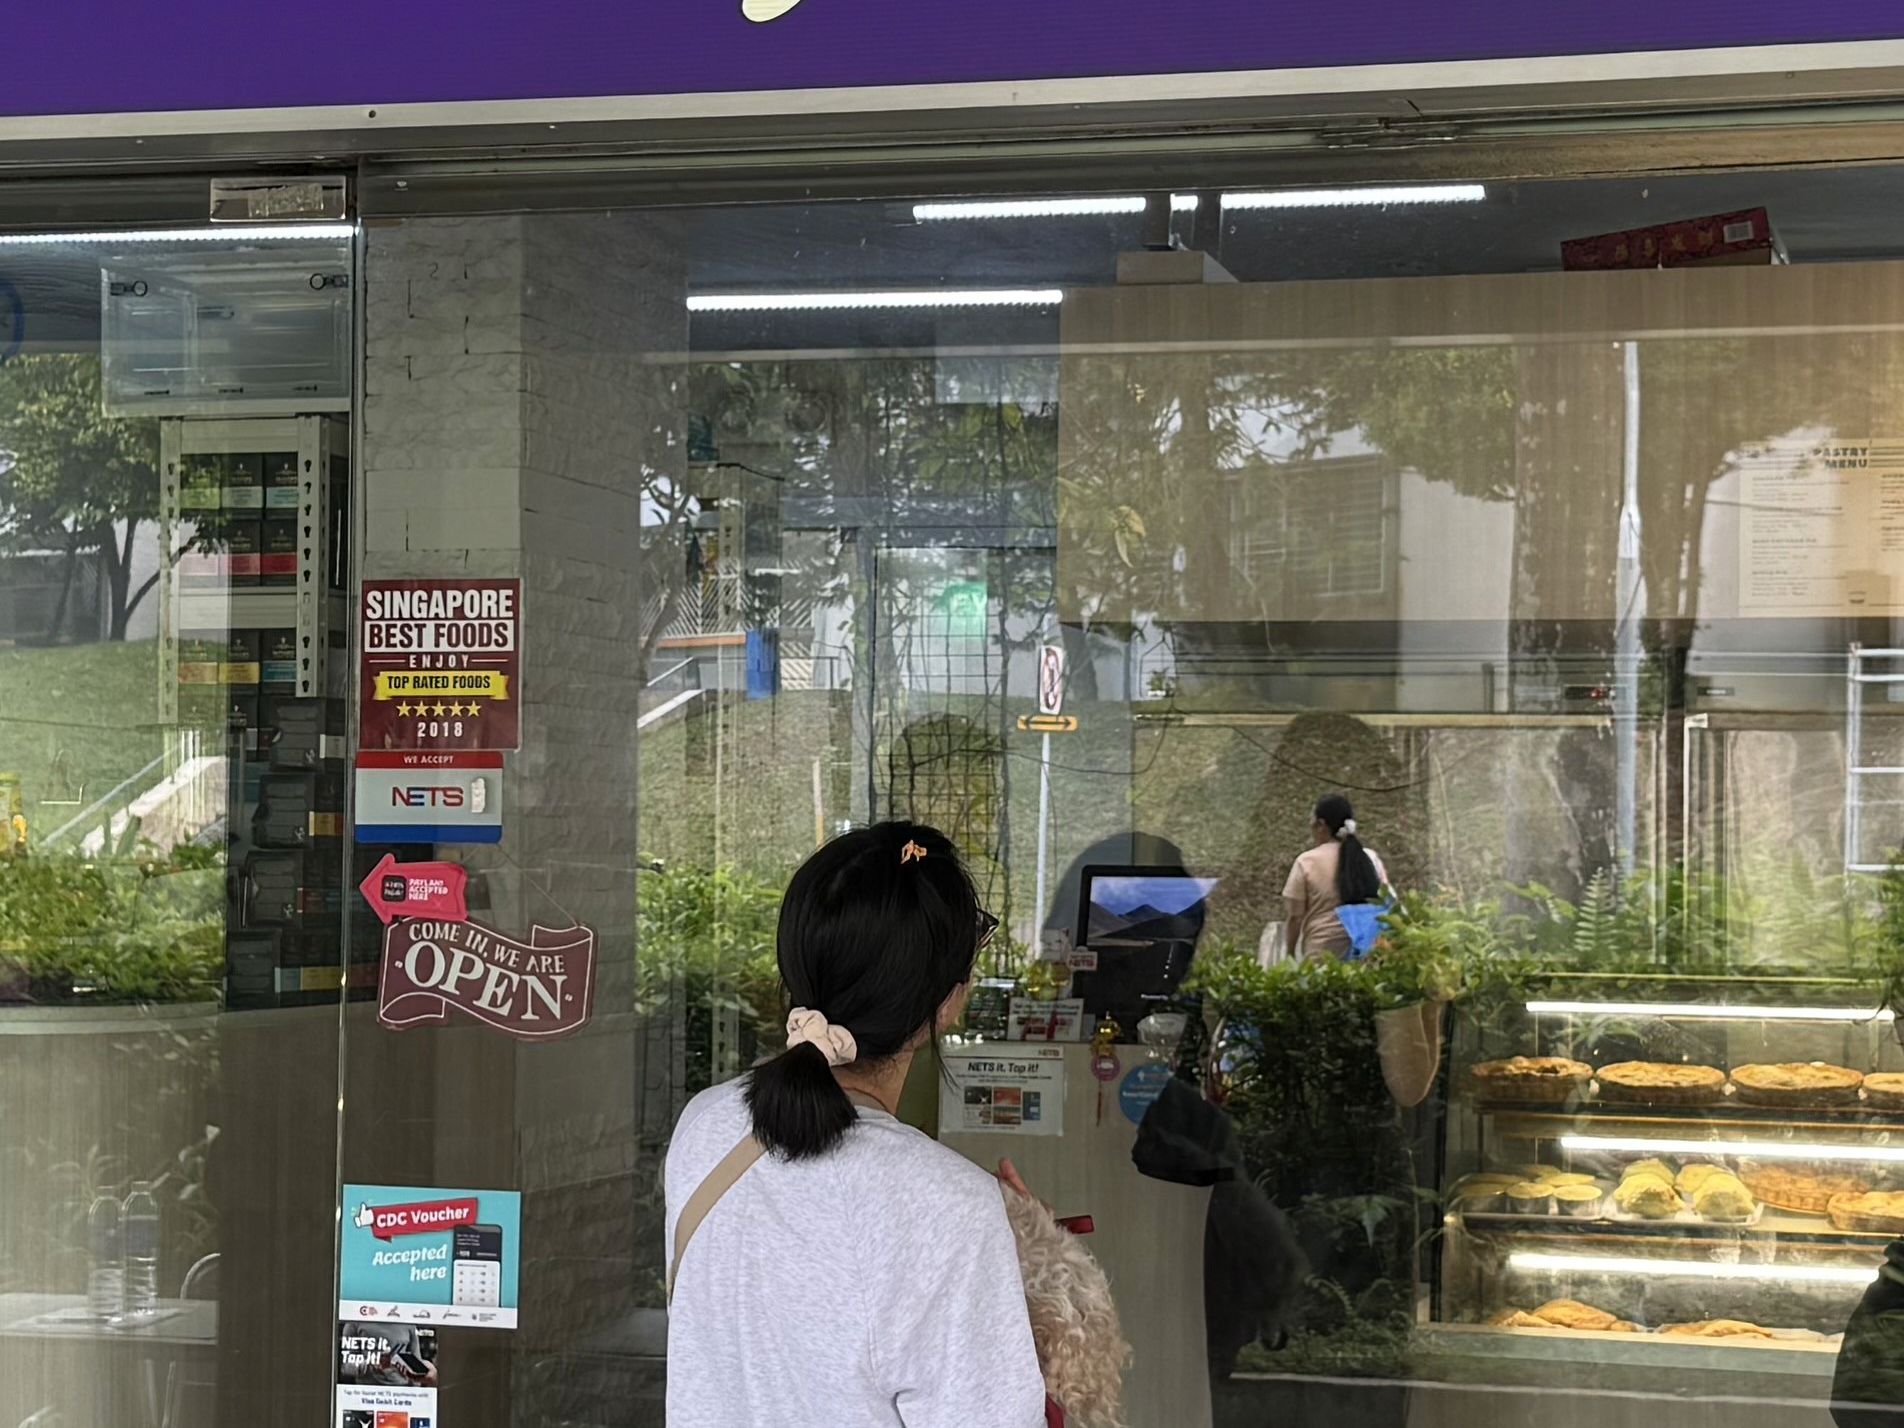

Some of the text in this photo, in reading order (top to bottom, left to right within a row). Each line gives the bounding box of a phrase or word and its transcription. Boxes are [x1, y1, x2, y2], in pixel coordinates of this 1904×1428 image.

[366, 589, 513, 620] SINGAPORE
[369, 622, 509, 649] BEST FOODS
[410, 654, 469, 668] ENJOY
[388, 675, 490, 688] TOP RATED FOODS
[418, 721, 461, 737] 2018
[404, 755, 454, 764] WE ACCEPT
[392, 787, 463, 806] NETS
[409, 886, 448, 894] ACCEPTED
[409, 922, 459, 944] COME
[494, 944, 520, 968] WE
[526, 955, 564, 973] ARE
[405, 941, 567, 1020] OPEN
[968, 1062, 995, 1072] NETS
[1008, 1063, 1026, 1074] Tap
[1028, 1062, 1039, 1072] it!
[377, 1207, 469, 1227] CDC Voucher
[373, 1244, 448, 1267] Accepted
[409, 1266, 446, 1282] here
[341, 1336, 375, 1350] NETS
[341, 1351, 381, 1367] Tap it!
